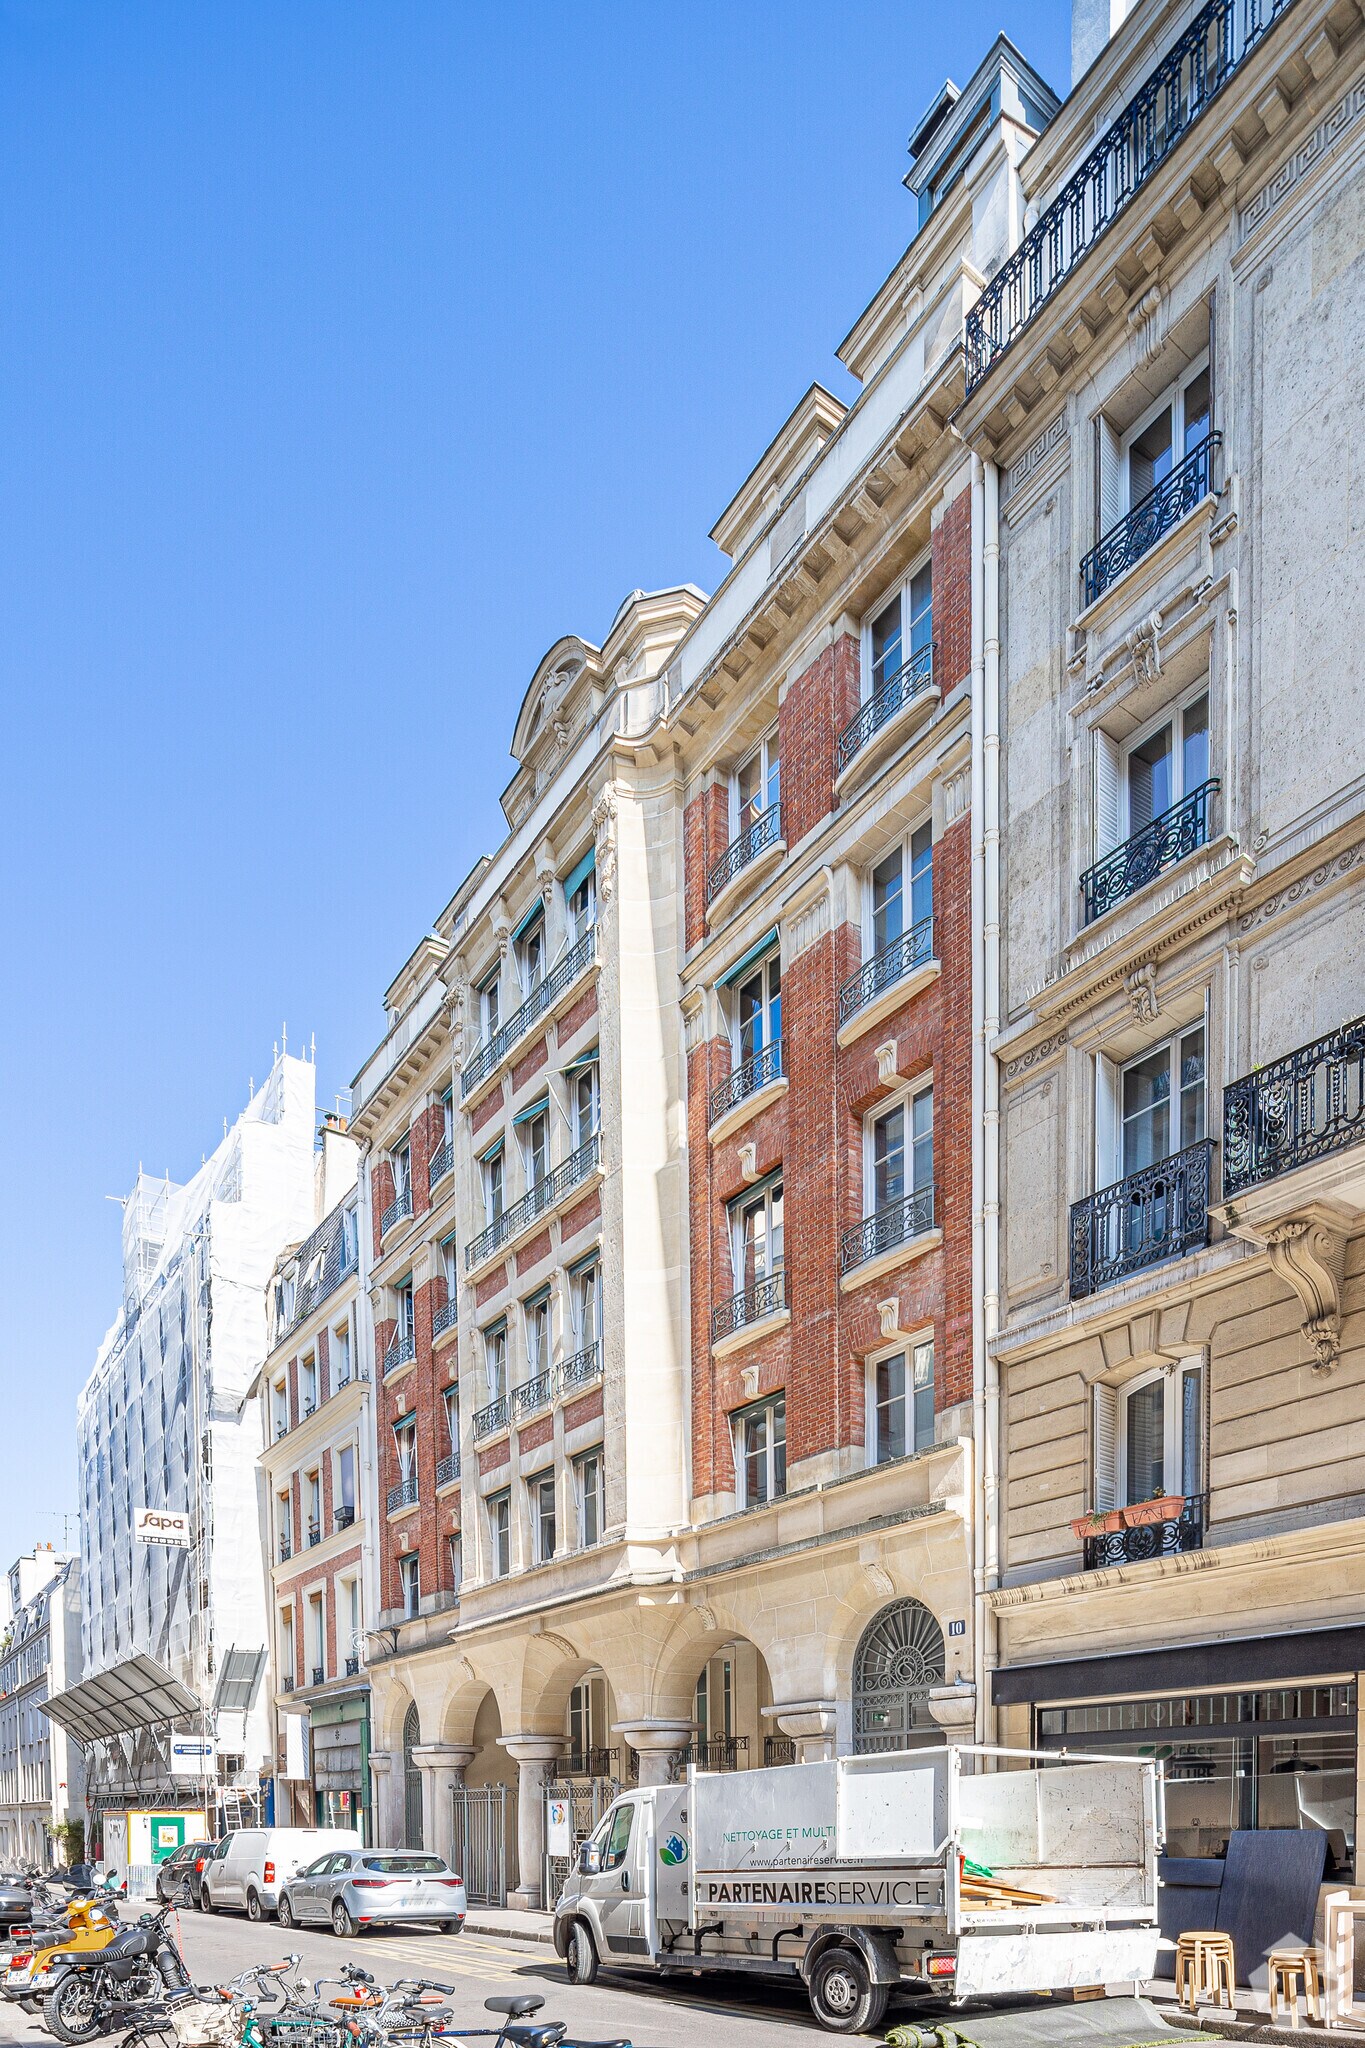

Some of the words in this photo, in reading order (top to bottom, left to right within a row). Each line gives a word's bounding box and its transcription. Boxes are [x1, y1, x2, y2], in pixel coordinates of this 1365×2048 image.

[139, 1513, 184, 1530] Sapa
[951, 1622, 963, 1635] 10
[723, 1829, 782, 1842] NETTOYAGE
[786, 1828, 799, 1839] ET
[802, 1826, 836, 1838] MULTI
[708, 1881, 931, 1905] PARTENAIRESERVICE
